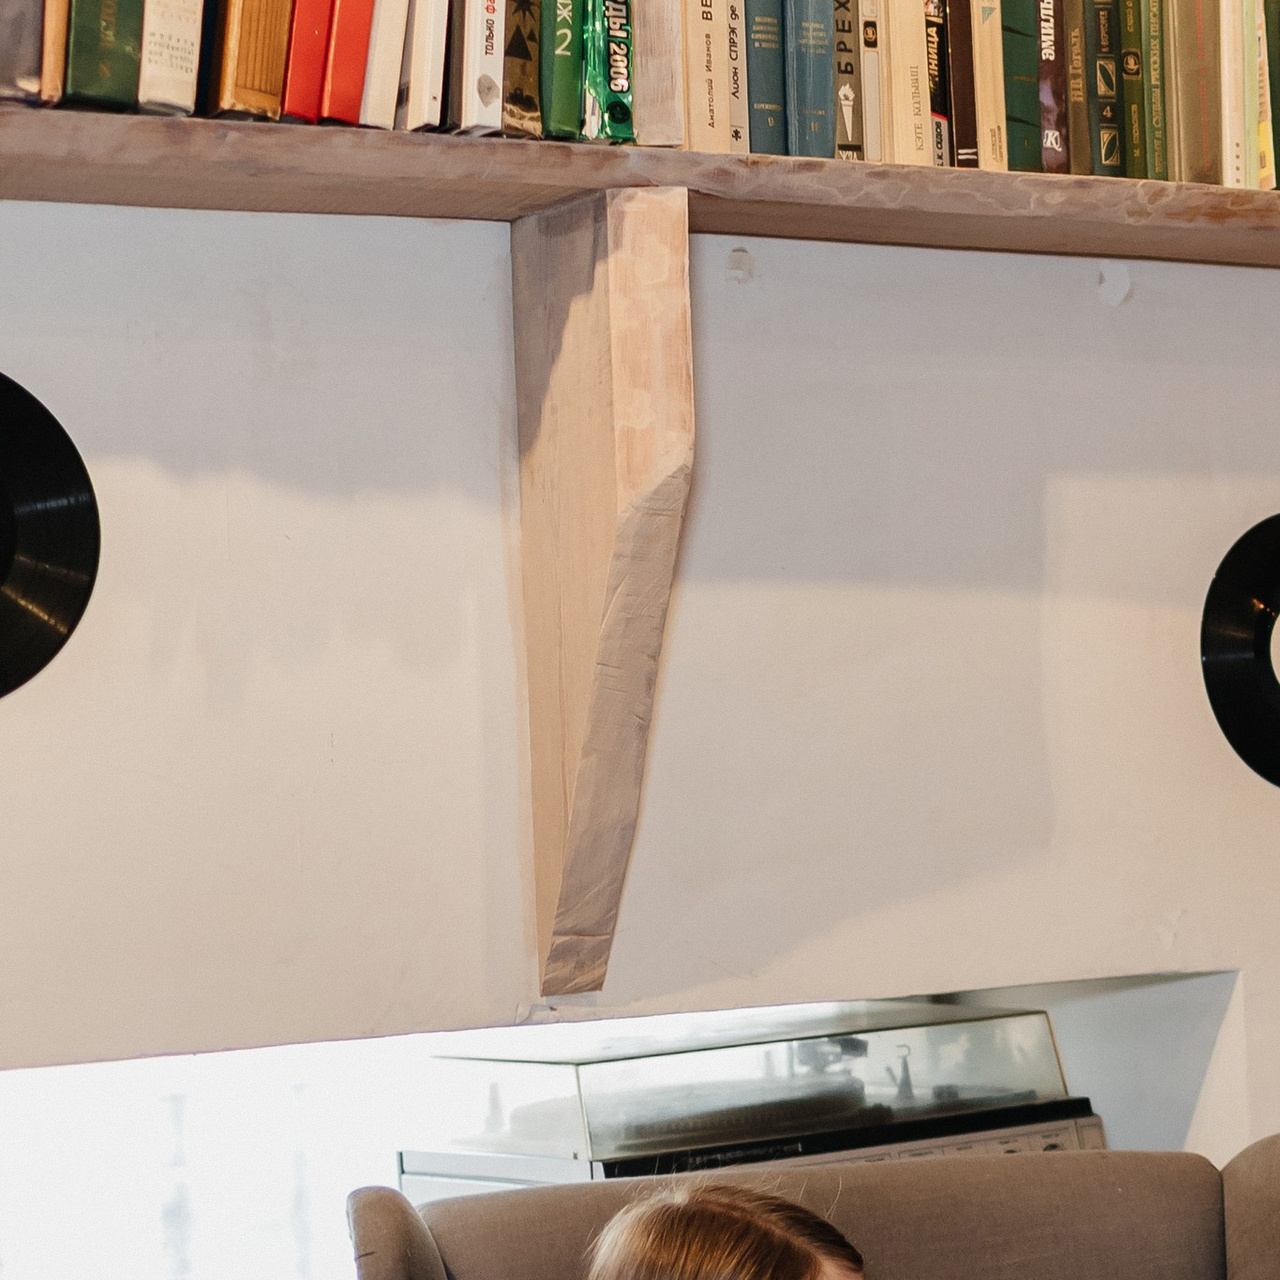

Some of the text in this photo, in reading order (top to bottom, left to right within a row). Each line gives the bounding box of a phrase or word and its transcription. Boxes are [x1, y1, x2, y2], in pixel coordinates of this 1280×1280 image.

[731, 2, 740, 20] де
[555, 28, 573, 56] 2
[704, 33, 713, 74] Иванов
[729, 22, 739, 61] СПРЭГ
[1069, 28, 1082, 75] Гоголь
[1150, 39, 1160, 86] РУССКИХ
[607, 43, 629, 93] 2006
[731, 66, 740, 100] Лион
[707, 77, 717, 129] Анатолий
[909, 65, 924, 151] КЭТЕ КОЛЬВИЦ
